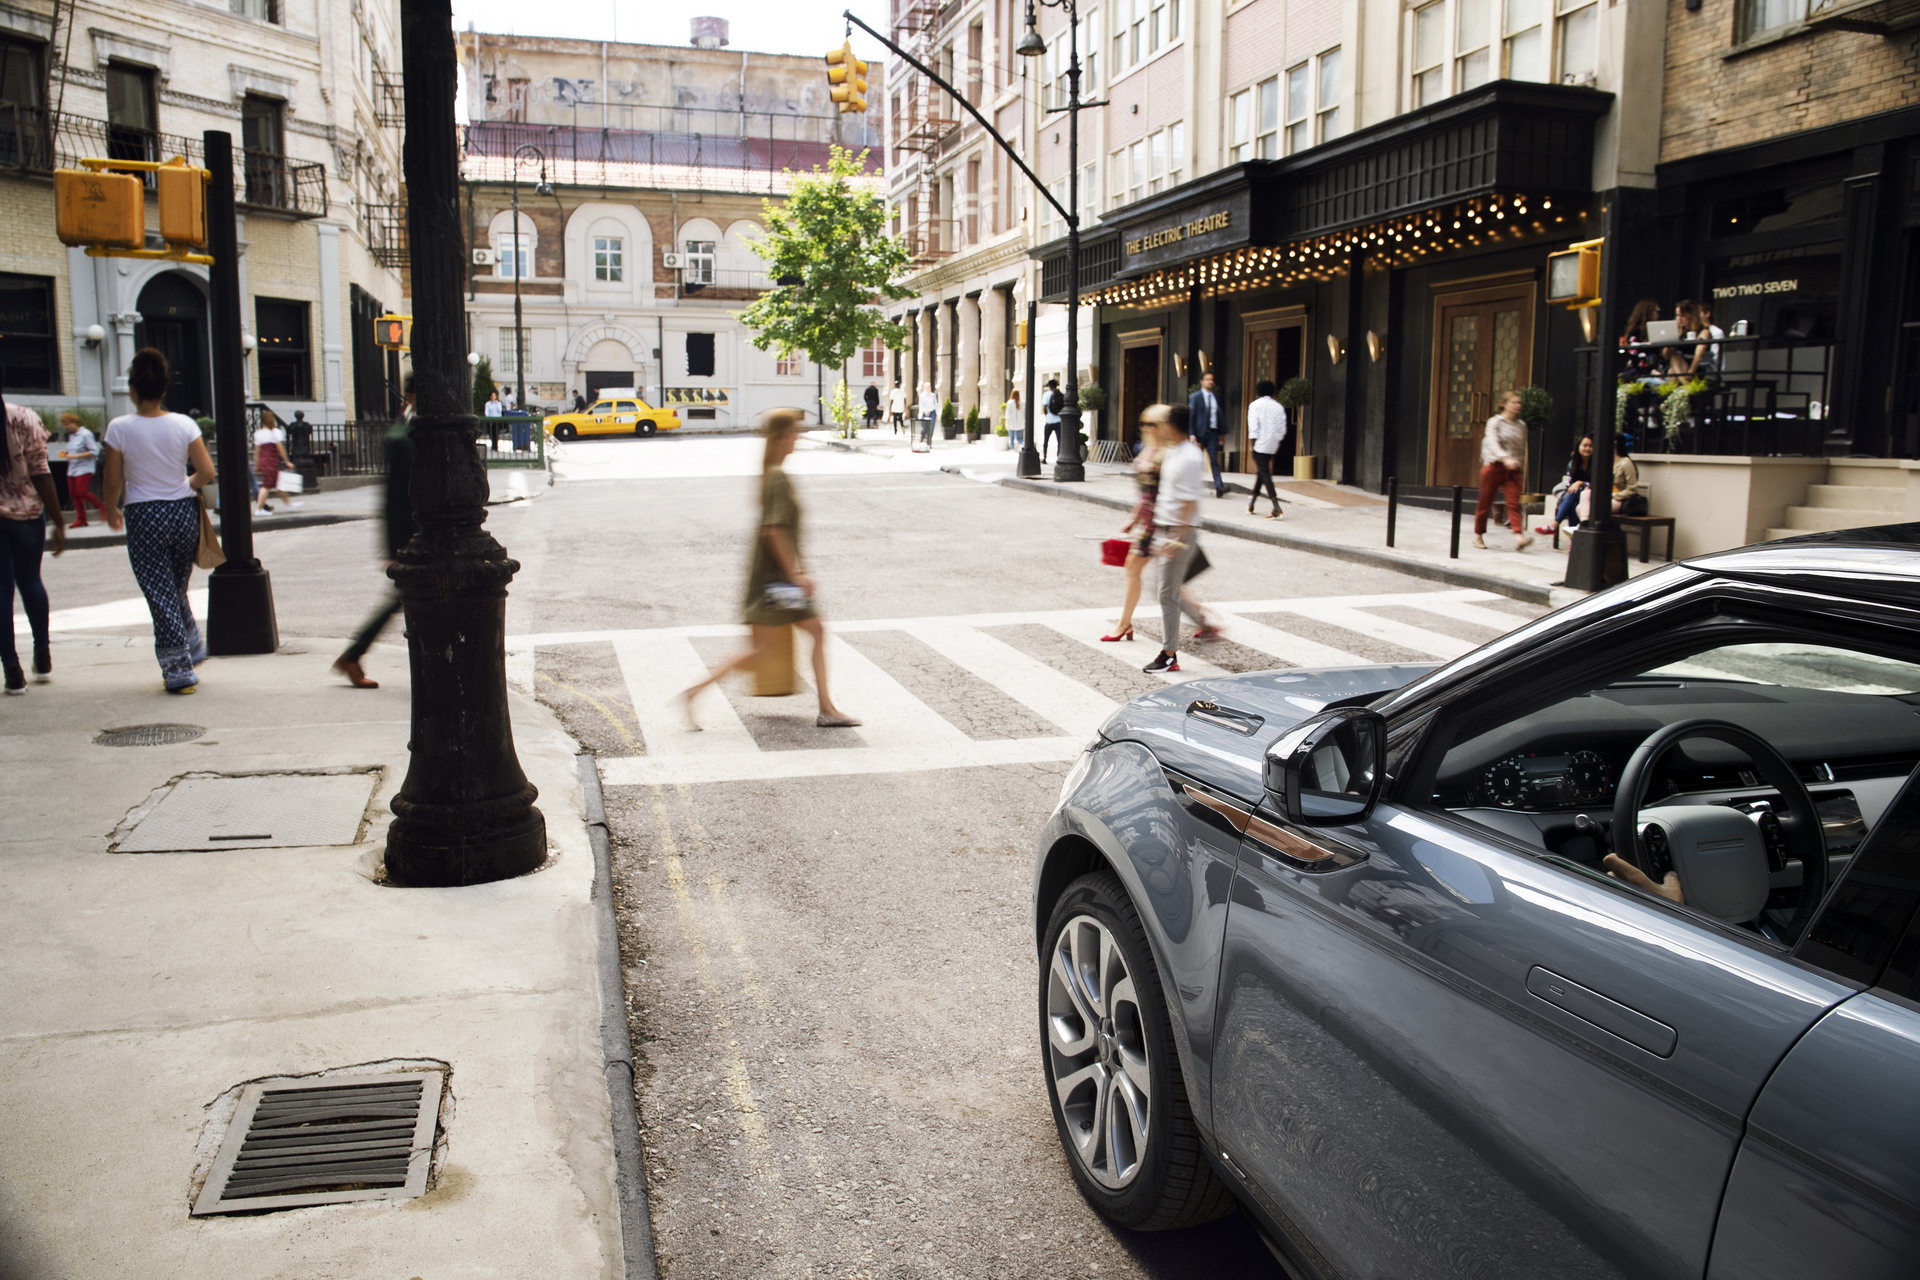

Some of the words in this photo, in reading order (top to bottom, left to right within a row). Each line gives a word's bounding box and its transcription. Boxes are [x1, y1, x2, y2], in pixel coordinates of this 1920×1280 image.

[1125, 239, 1141, 256] THE
[1143, 225, 1184, 250] ELECTRIC
[1186, 210, 1230, 238] THEATRE
[1712, 286, 1737, 298] TWO
[1738, 283, 1762, 296] TWO
[1764, 279, 1798, 293] SEVEN
[1504, 778, 1510, 786] 0
